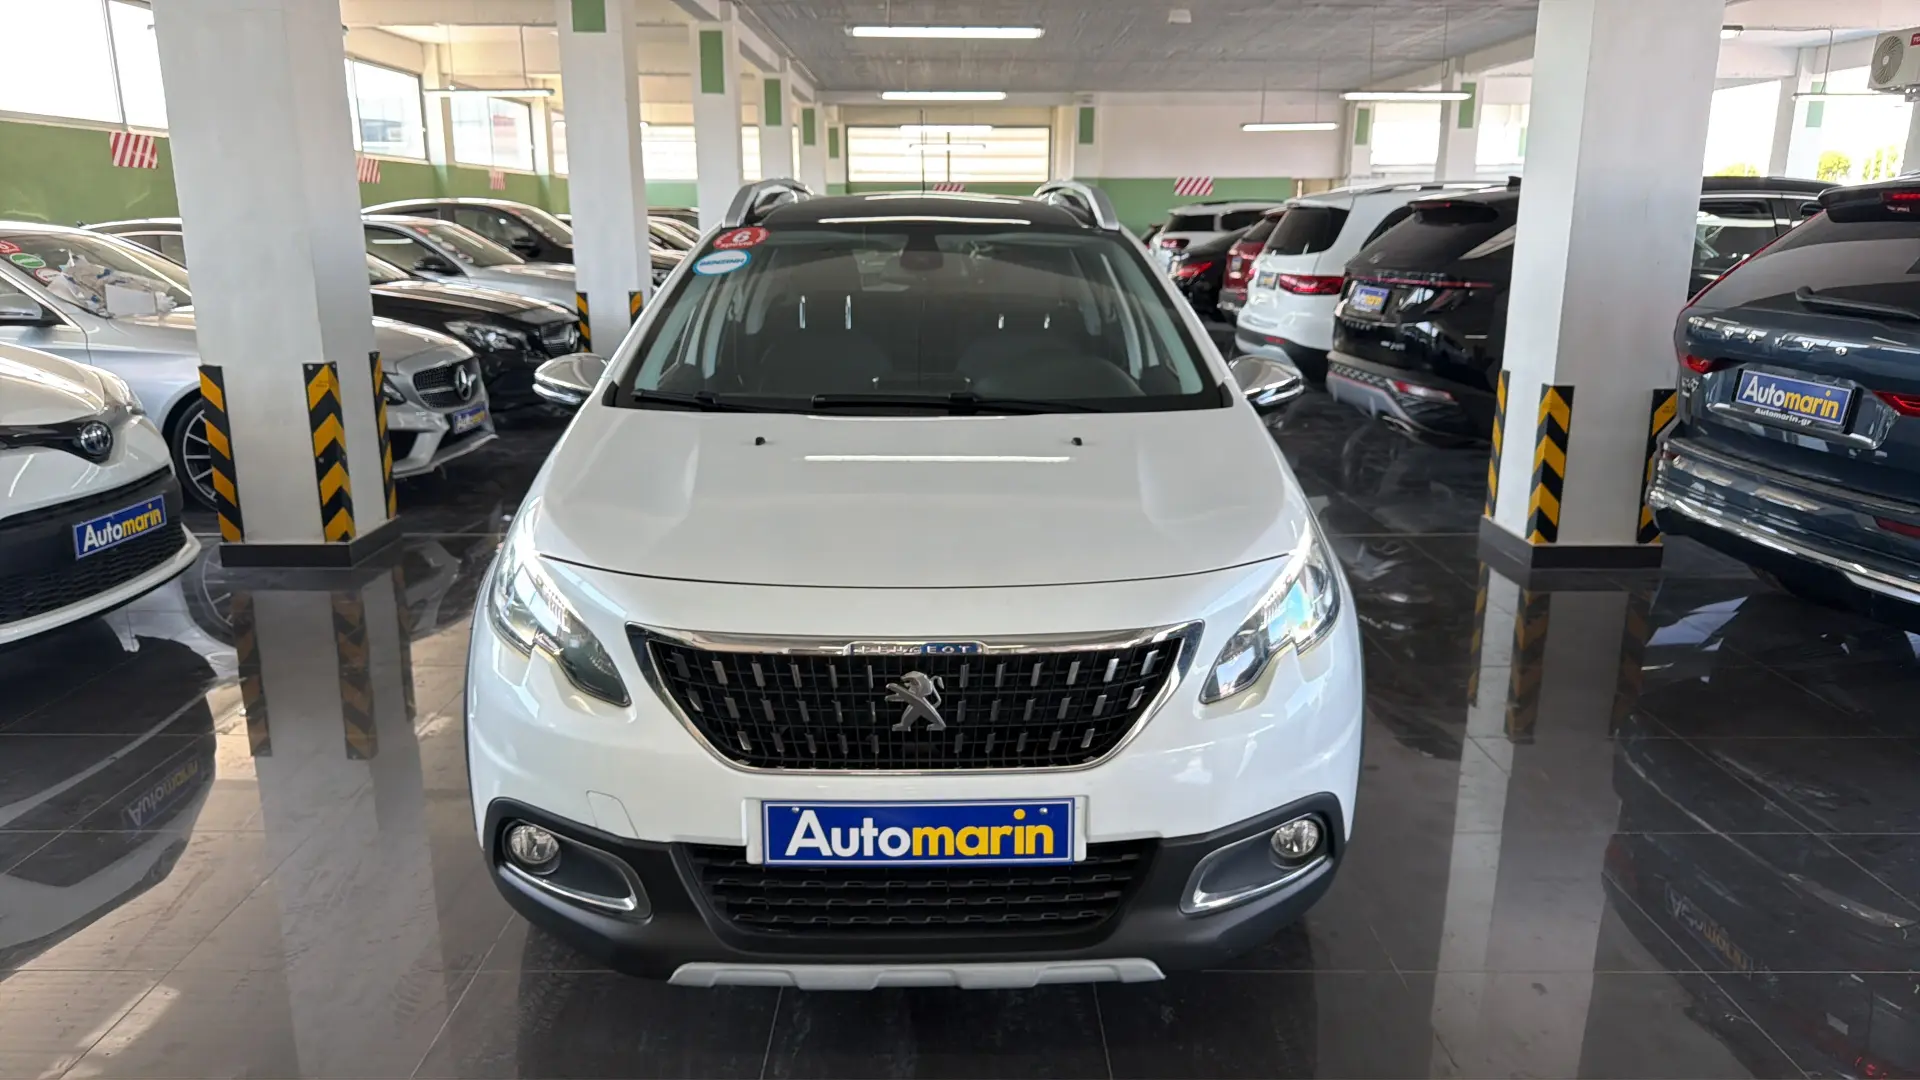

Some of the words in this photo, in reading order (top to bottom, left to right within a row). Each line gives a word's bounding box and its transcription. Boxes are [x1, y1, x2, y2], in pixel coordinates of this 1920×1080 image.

[1742, 375, 1840, 420] Automarin
[1754, 407, 1813, 427] Automarin.gr
[83, 503, 163, 553] Automarin
[784, 808, 1054, 858] Automarin
